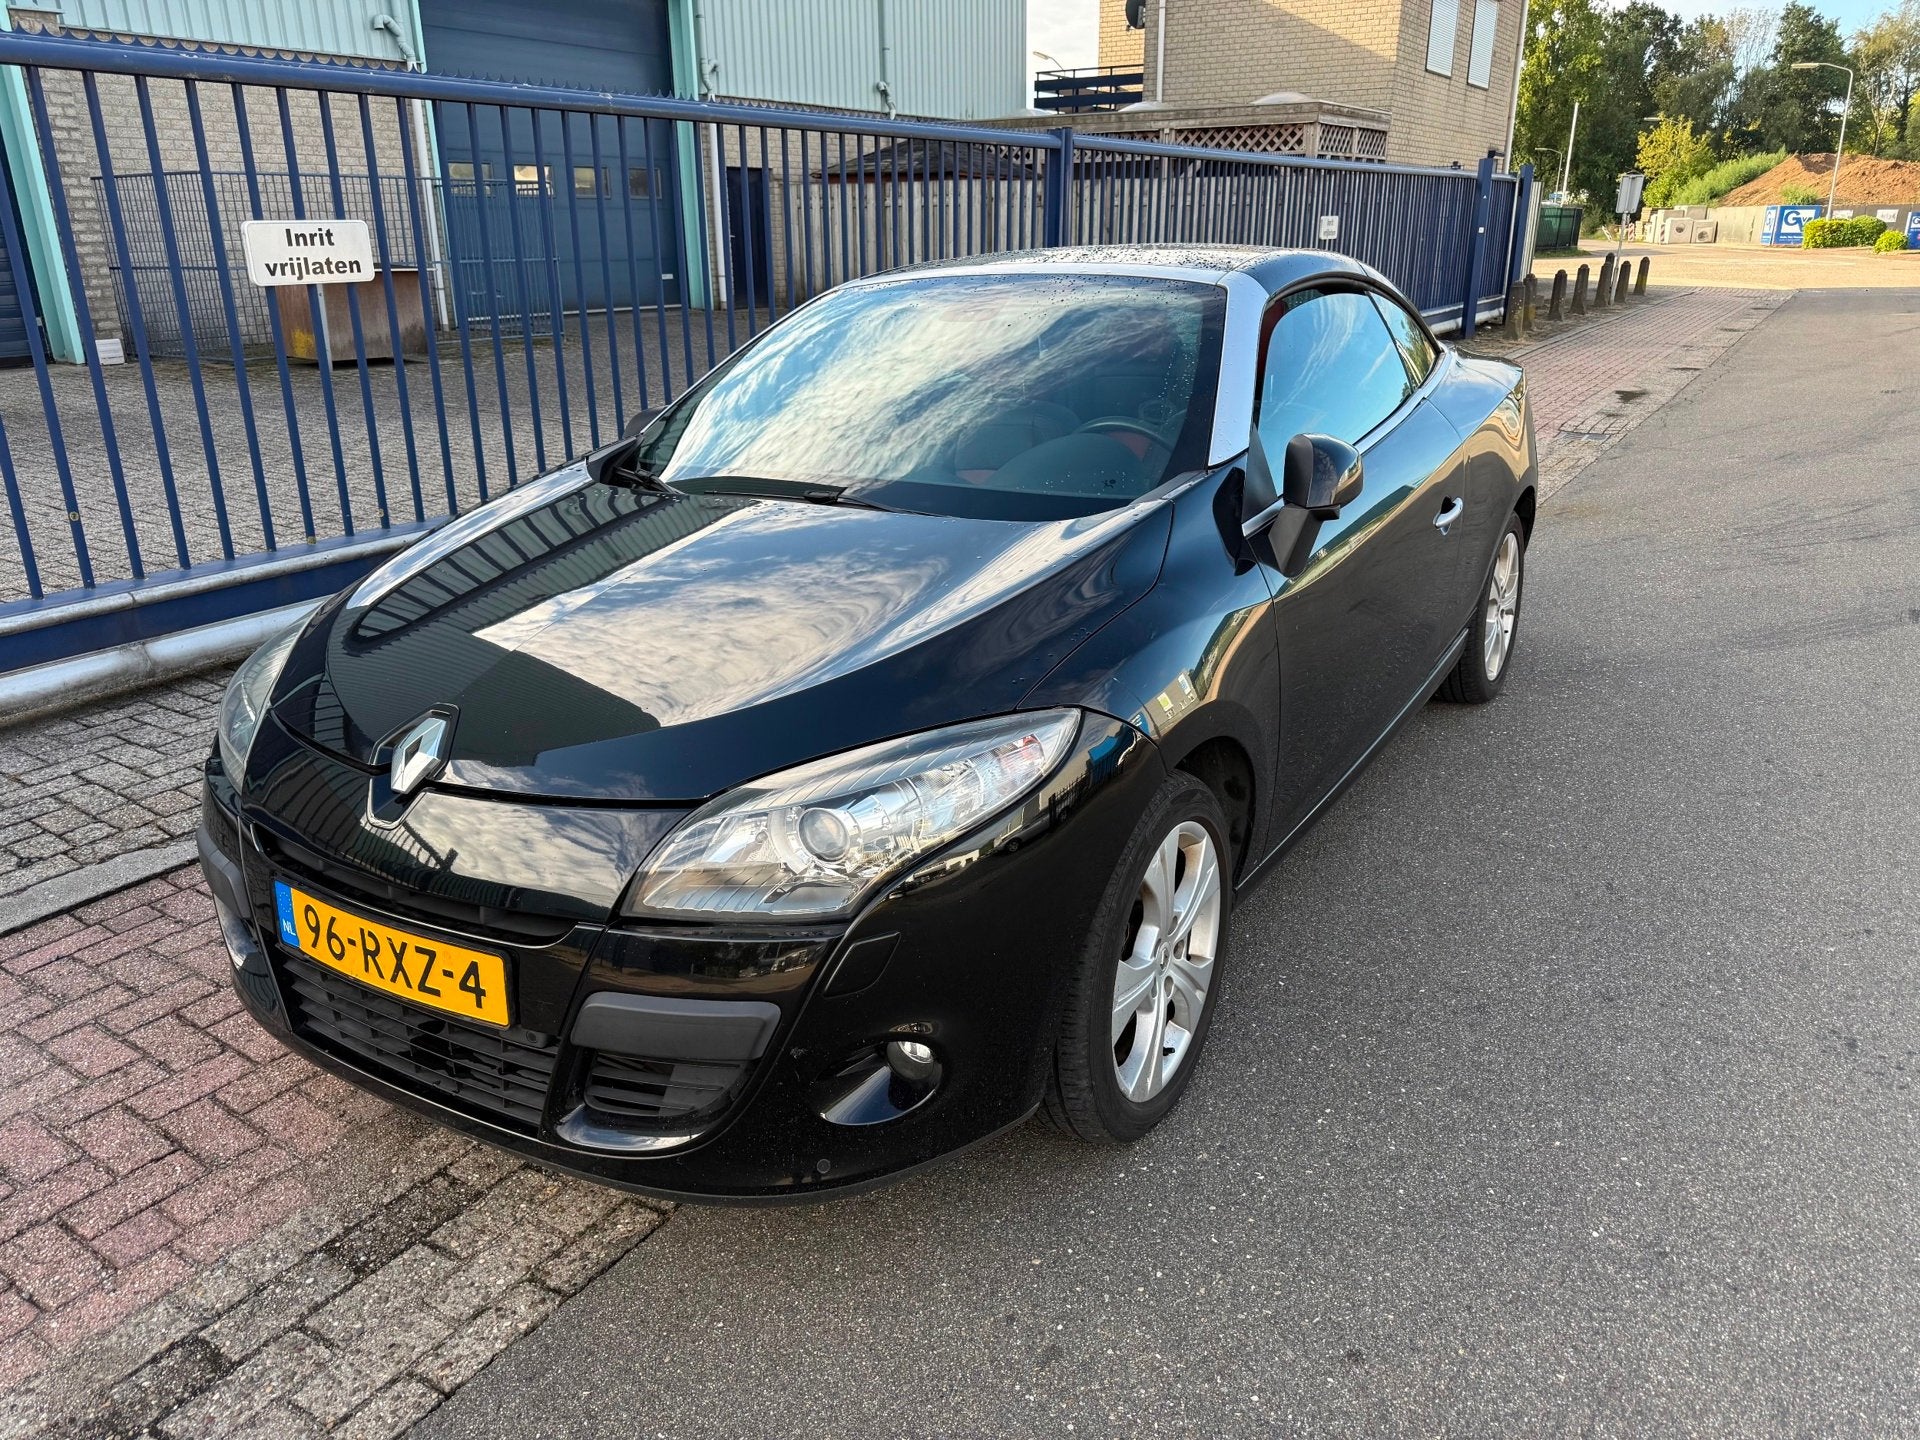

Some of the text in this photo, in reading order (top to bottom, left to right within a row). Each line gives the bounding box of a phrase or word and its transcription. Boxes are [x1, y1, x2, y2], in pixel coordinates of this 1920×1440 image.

[285, 228, 335, 247] Inrit
[265, 257, 362, 280] vrijlaten
[282, 918, 297, 937] NL
[304, 904, 486, 1009] 96-RXZ-4
